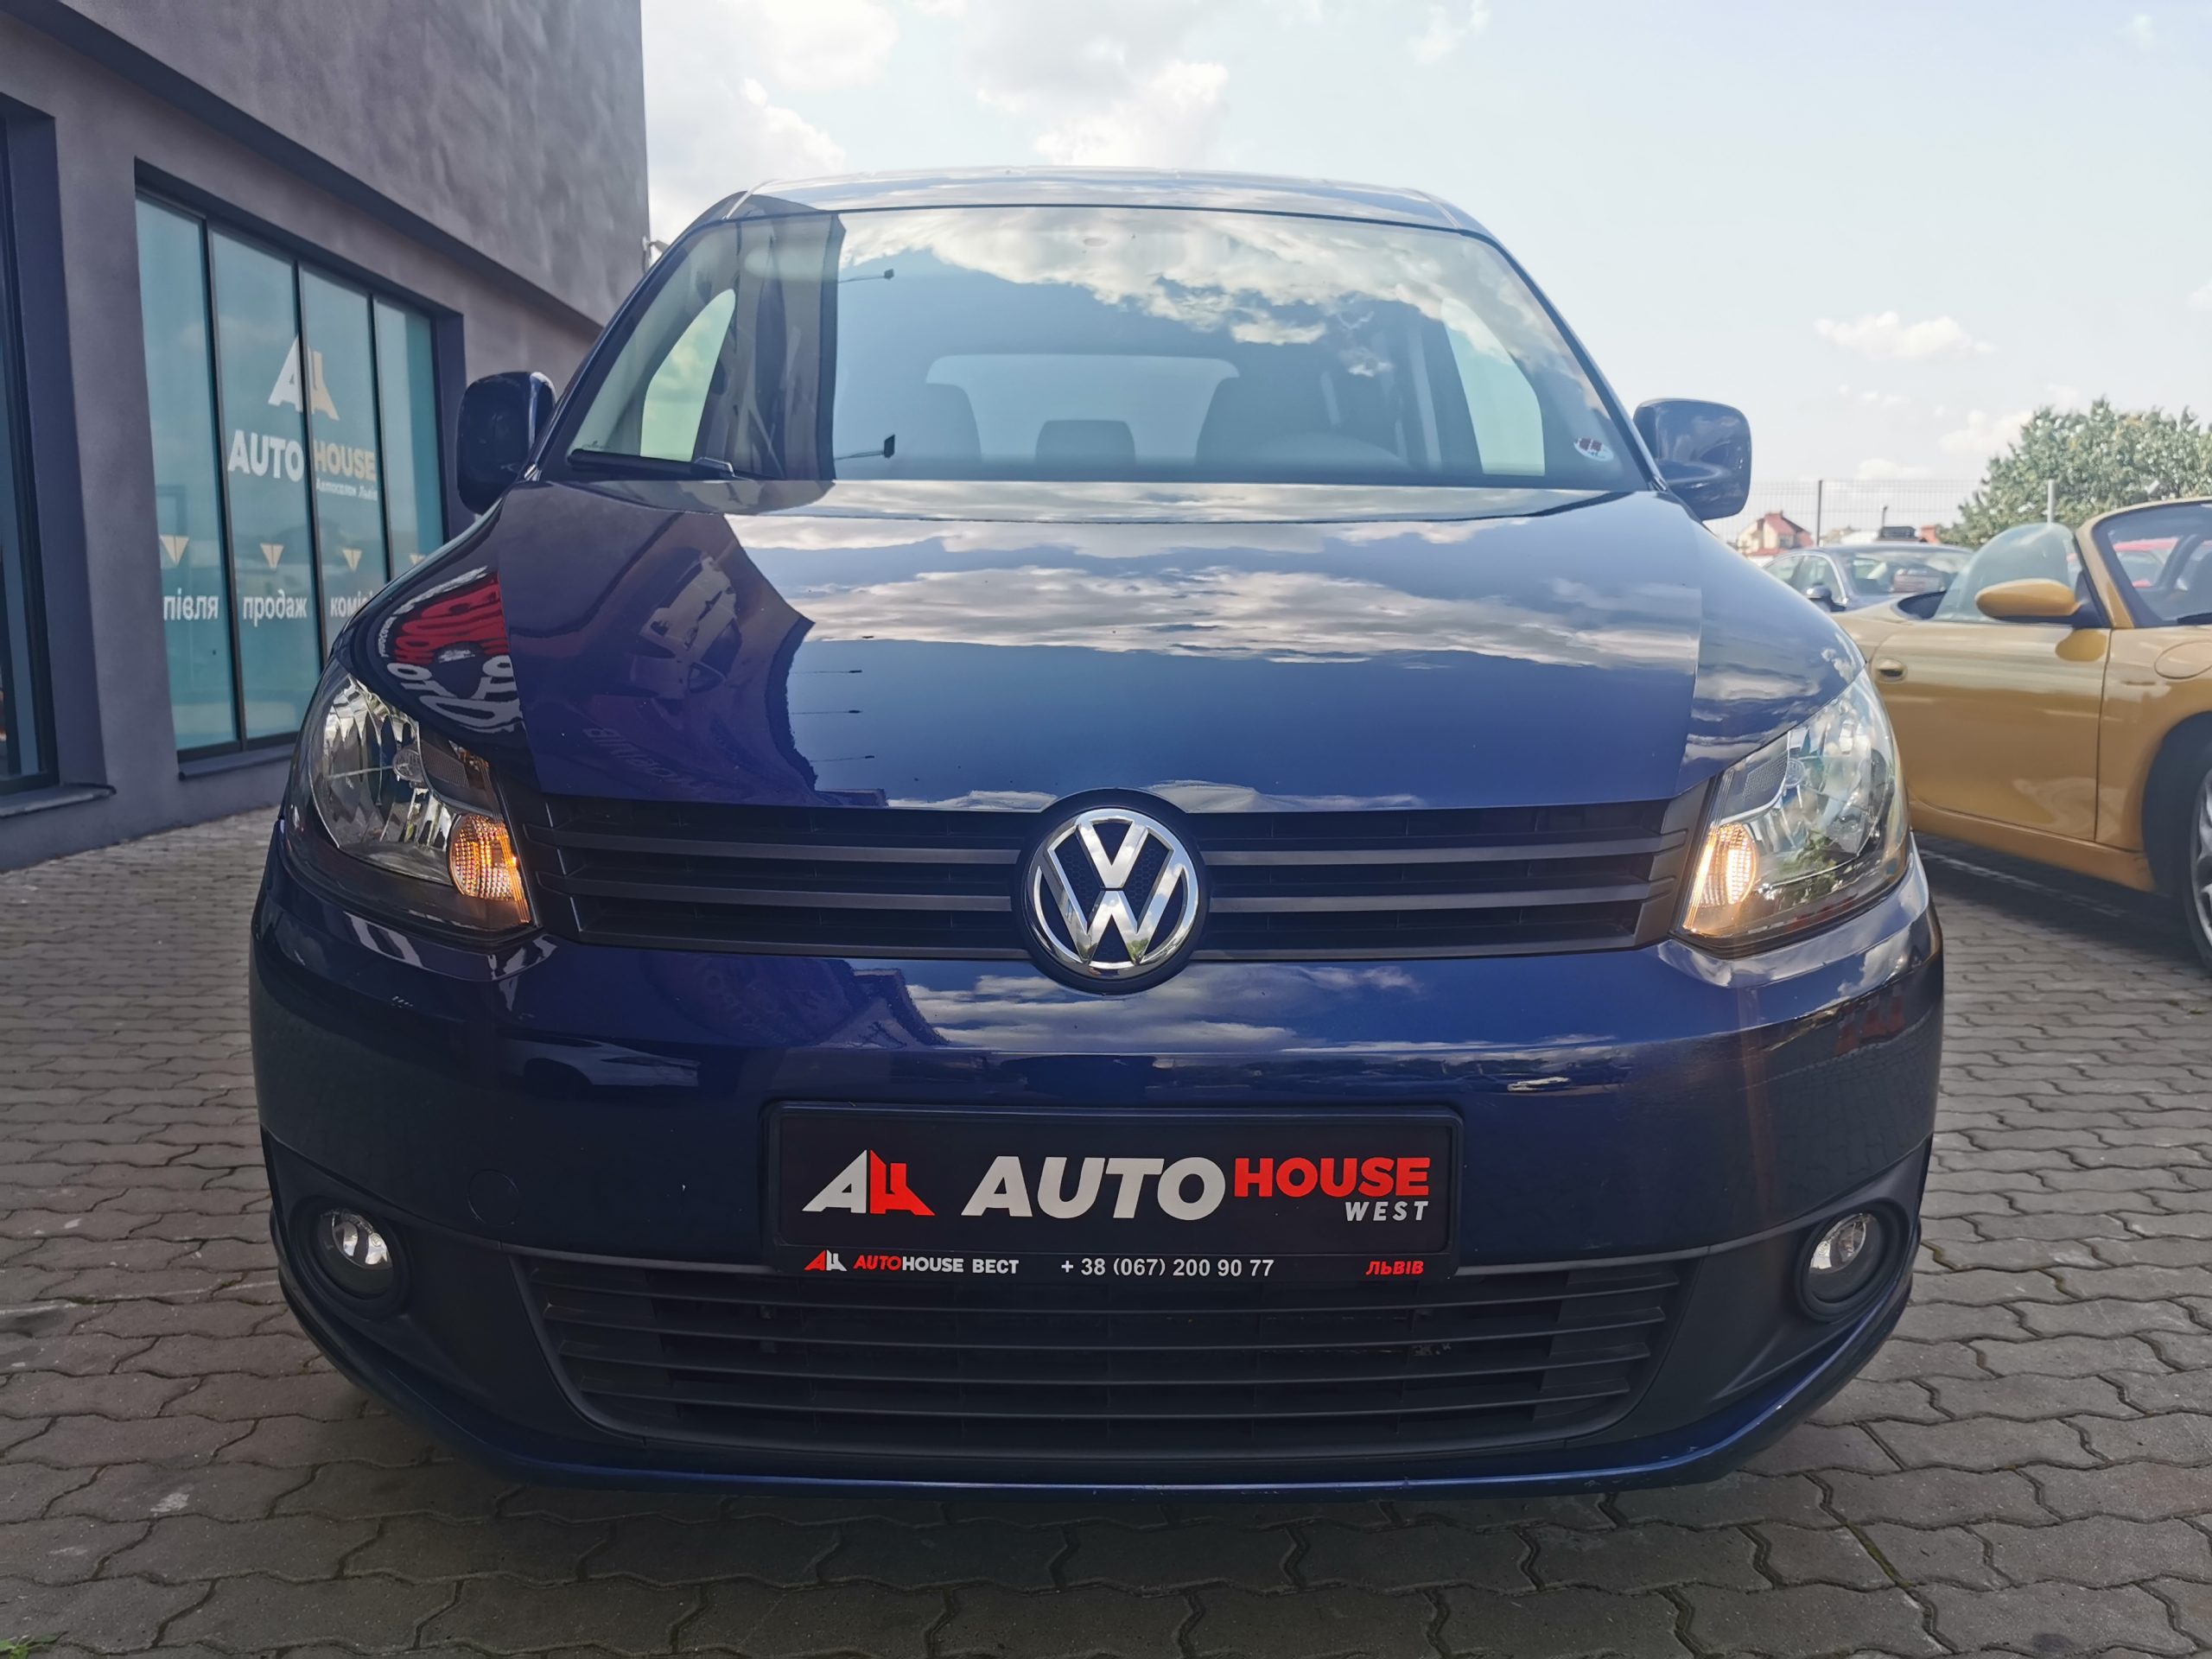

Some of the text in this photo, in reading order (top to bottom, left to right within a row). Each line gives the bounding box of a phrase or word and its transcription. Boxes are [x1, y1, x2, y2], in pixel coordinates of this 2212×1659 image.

[227, 429, 378, 481] AUTO HOUSE
[243, 588, 308, 627] продаж
[961, 1155, 1431, 1221] AUTO HOUSE
[1344, 1200, 1429, 1222] WEST
[853, 1255, 963, 1273] AUTOHOUSE
[1112, 1257, 1166, 1277] (067)
[1173, 1258, 1210, 1277] 200
[1217, 1259, 1243, 1277] 90
[1249, 1259, 1274, 1277] 77
[1365, 1260, 1424, 1275] ЛЬВІВ
